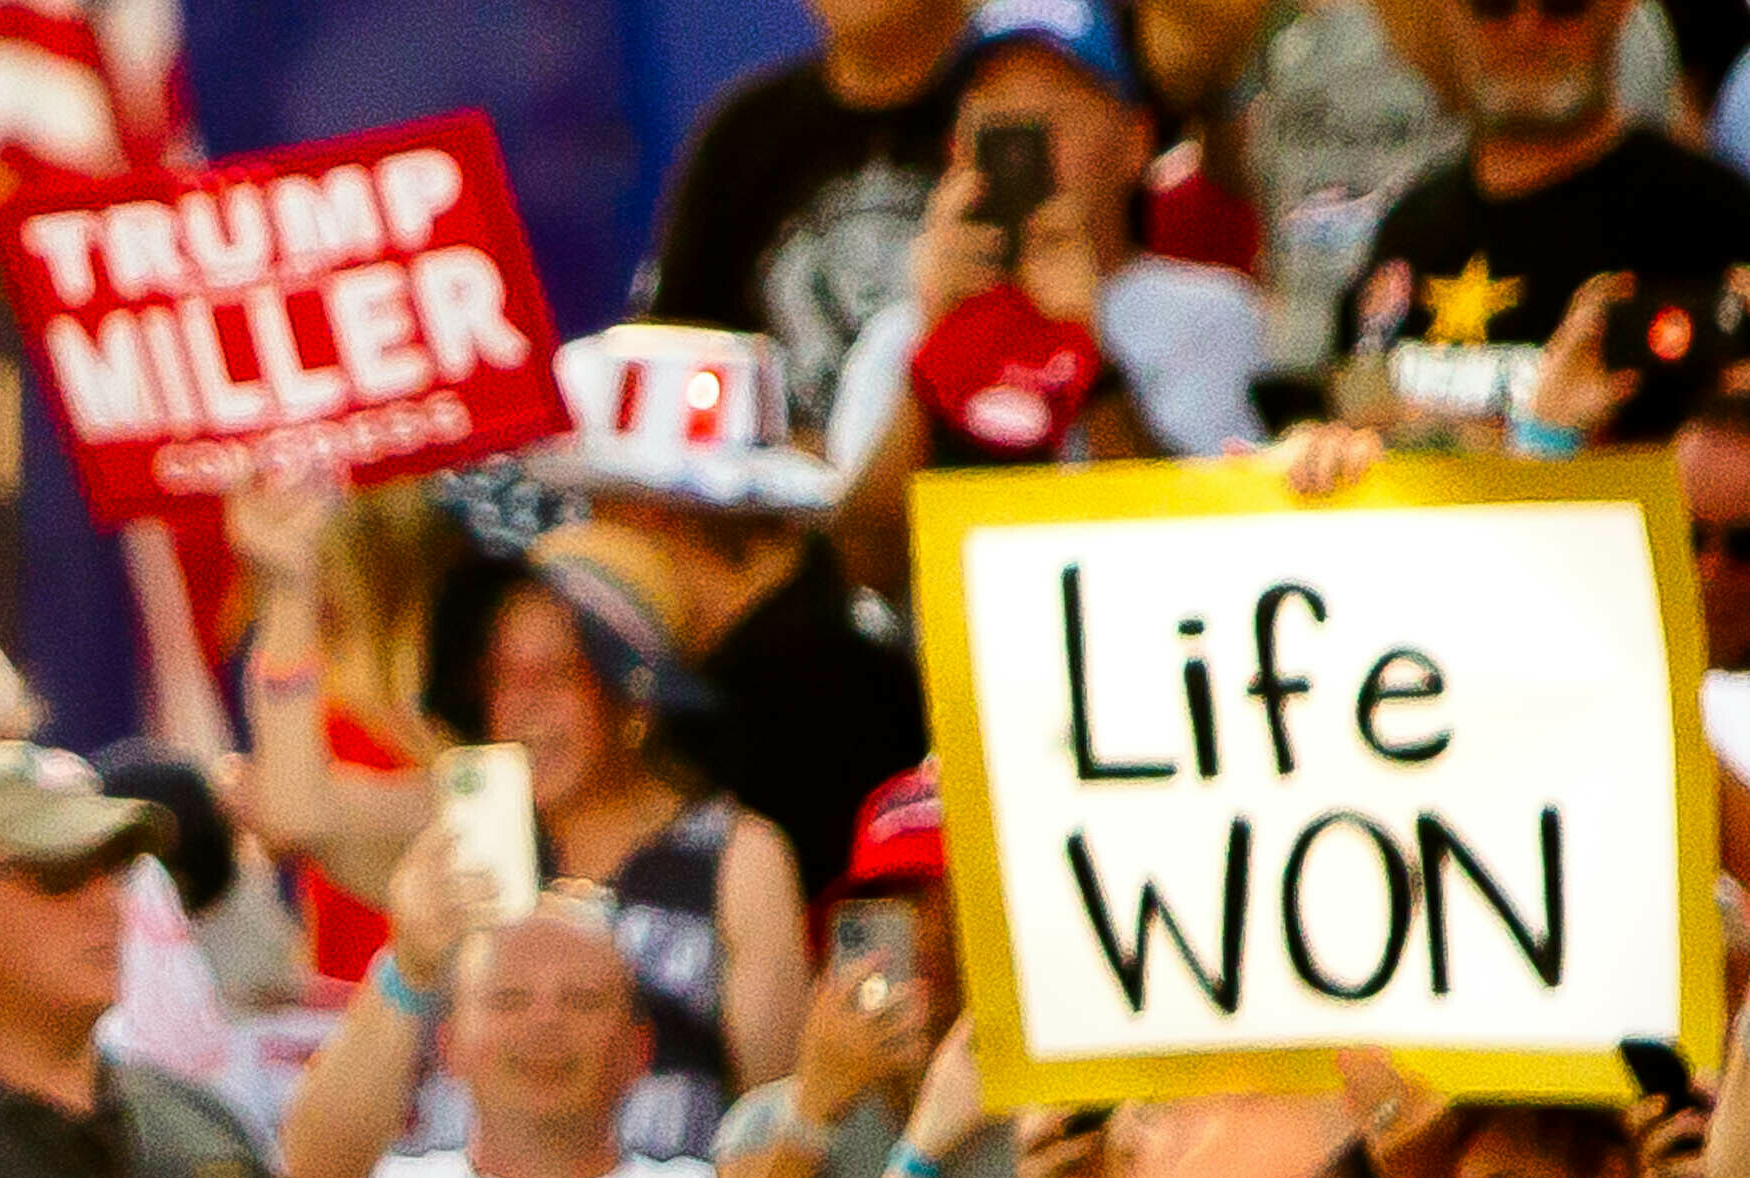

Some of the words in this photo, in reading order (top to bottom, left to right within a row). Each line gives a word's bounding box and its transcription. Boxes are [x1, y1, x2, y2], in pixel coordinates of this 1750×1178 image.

[22, 149, 462, 306] TRUMP
[46, 245, 531, 444] MILLER
[1061, 563, 1451, 780] Life
[1066, 804, 1564, 1014] WON
